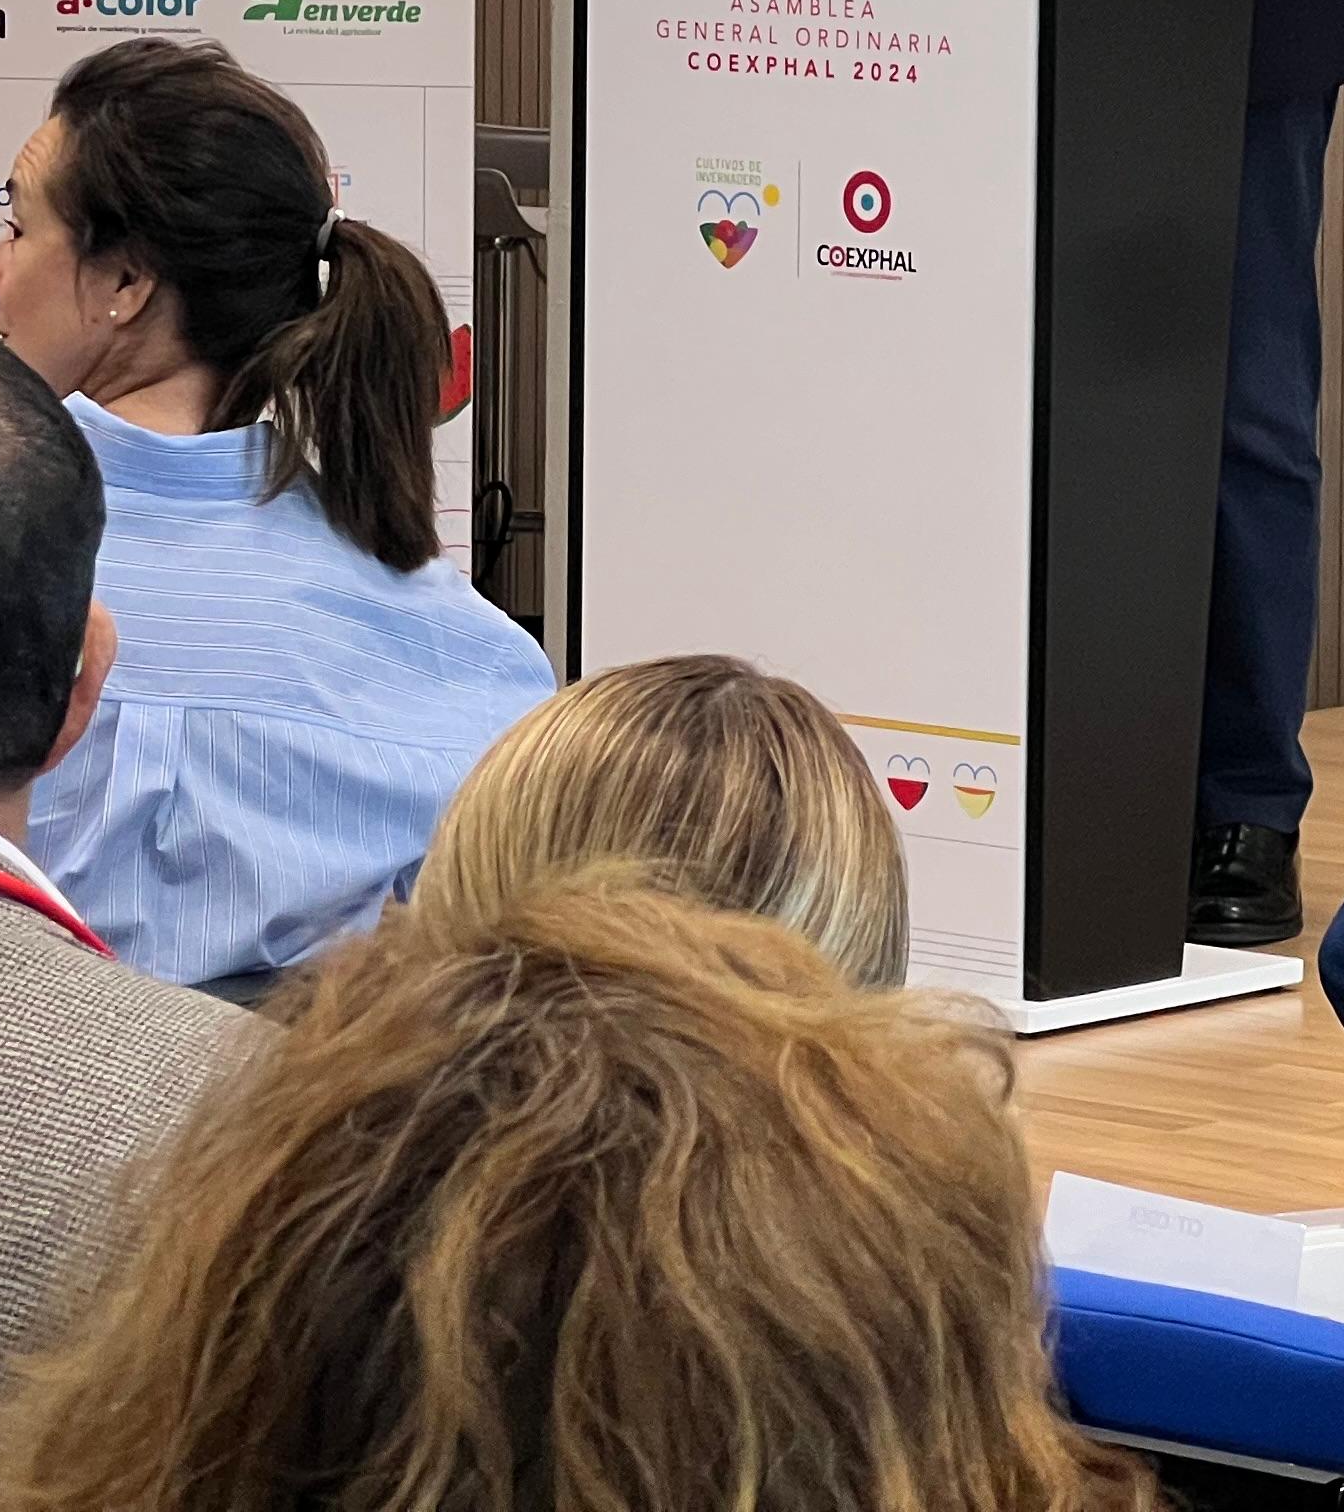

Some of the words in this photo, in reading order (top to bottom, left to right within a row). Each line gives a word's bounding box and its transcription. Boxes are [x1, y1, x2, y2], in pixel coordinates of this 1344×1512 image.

[656, 19, 778, 45] GENERAL
[796, 27, 952, 55] ORDINARIA
[688, 51, 836, 79] COEXPHAL
[853, 61, 918, 83] 2024
[696, 157, 745, 171] CULTIVOS
[748, 160, 761, 173] DE
[696, 171, 762, 186] INVERNADERO
[817, 244, 917, 273] COEXPHAL
